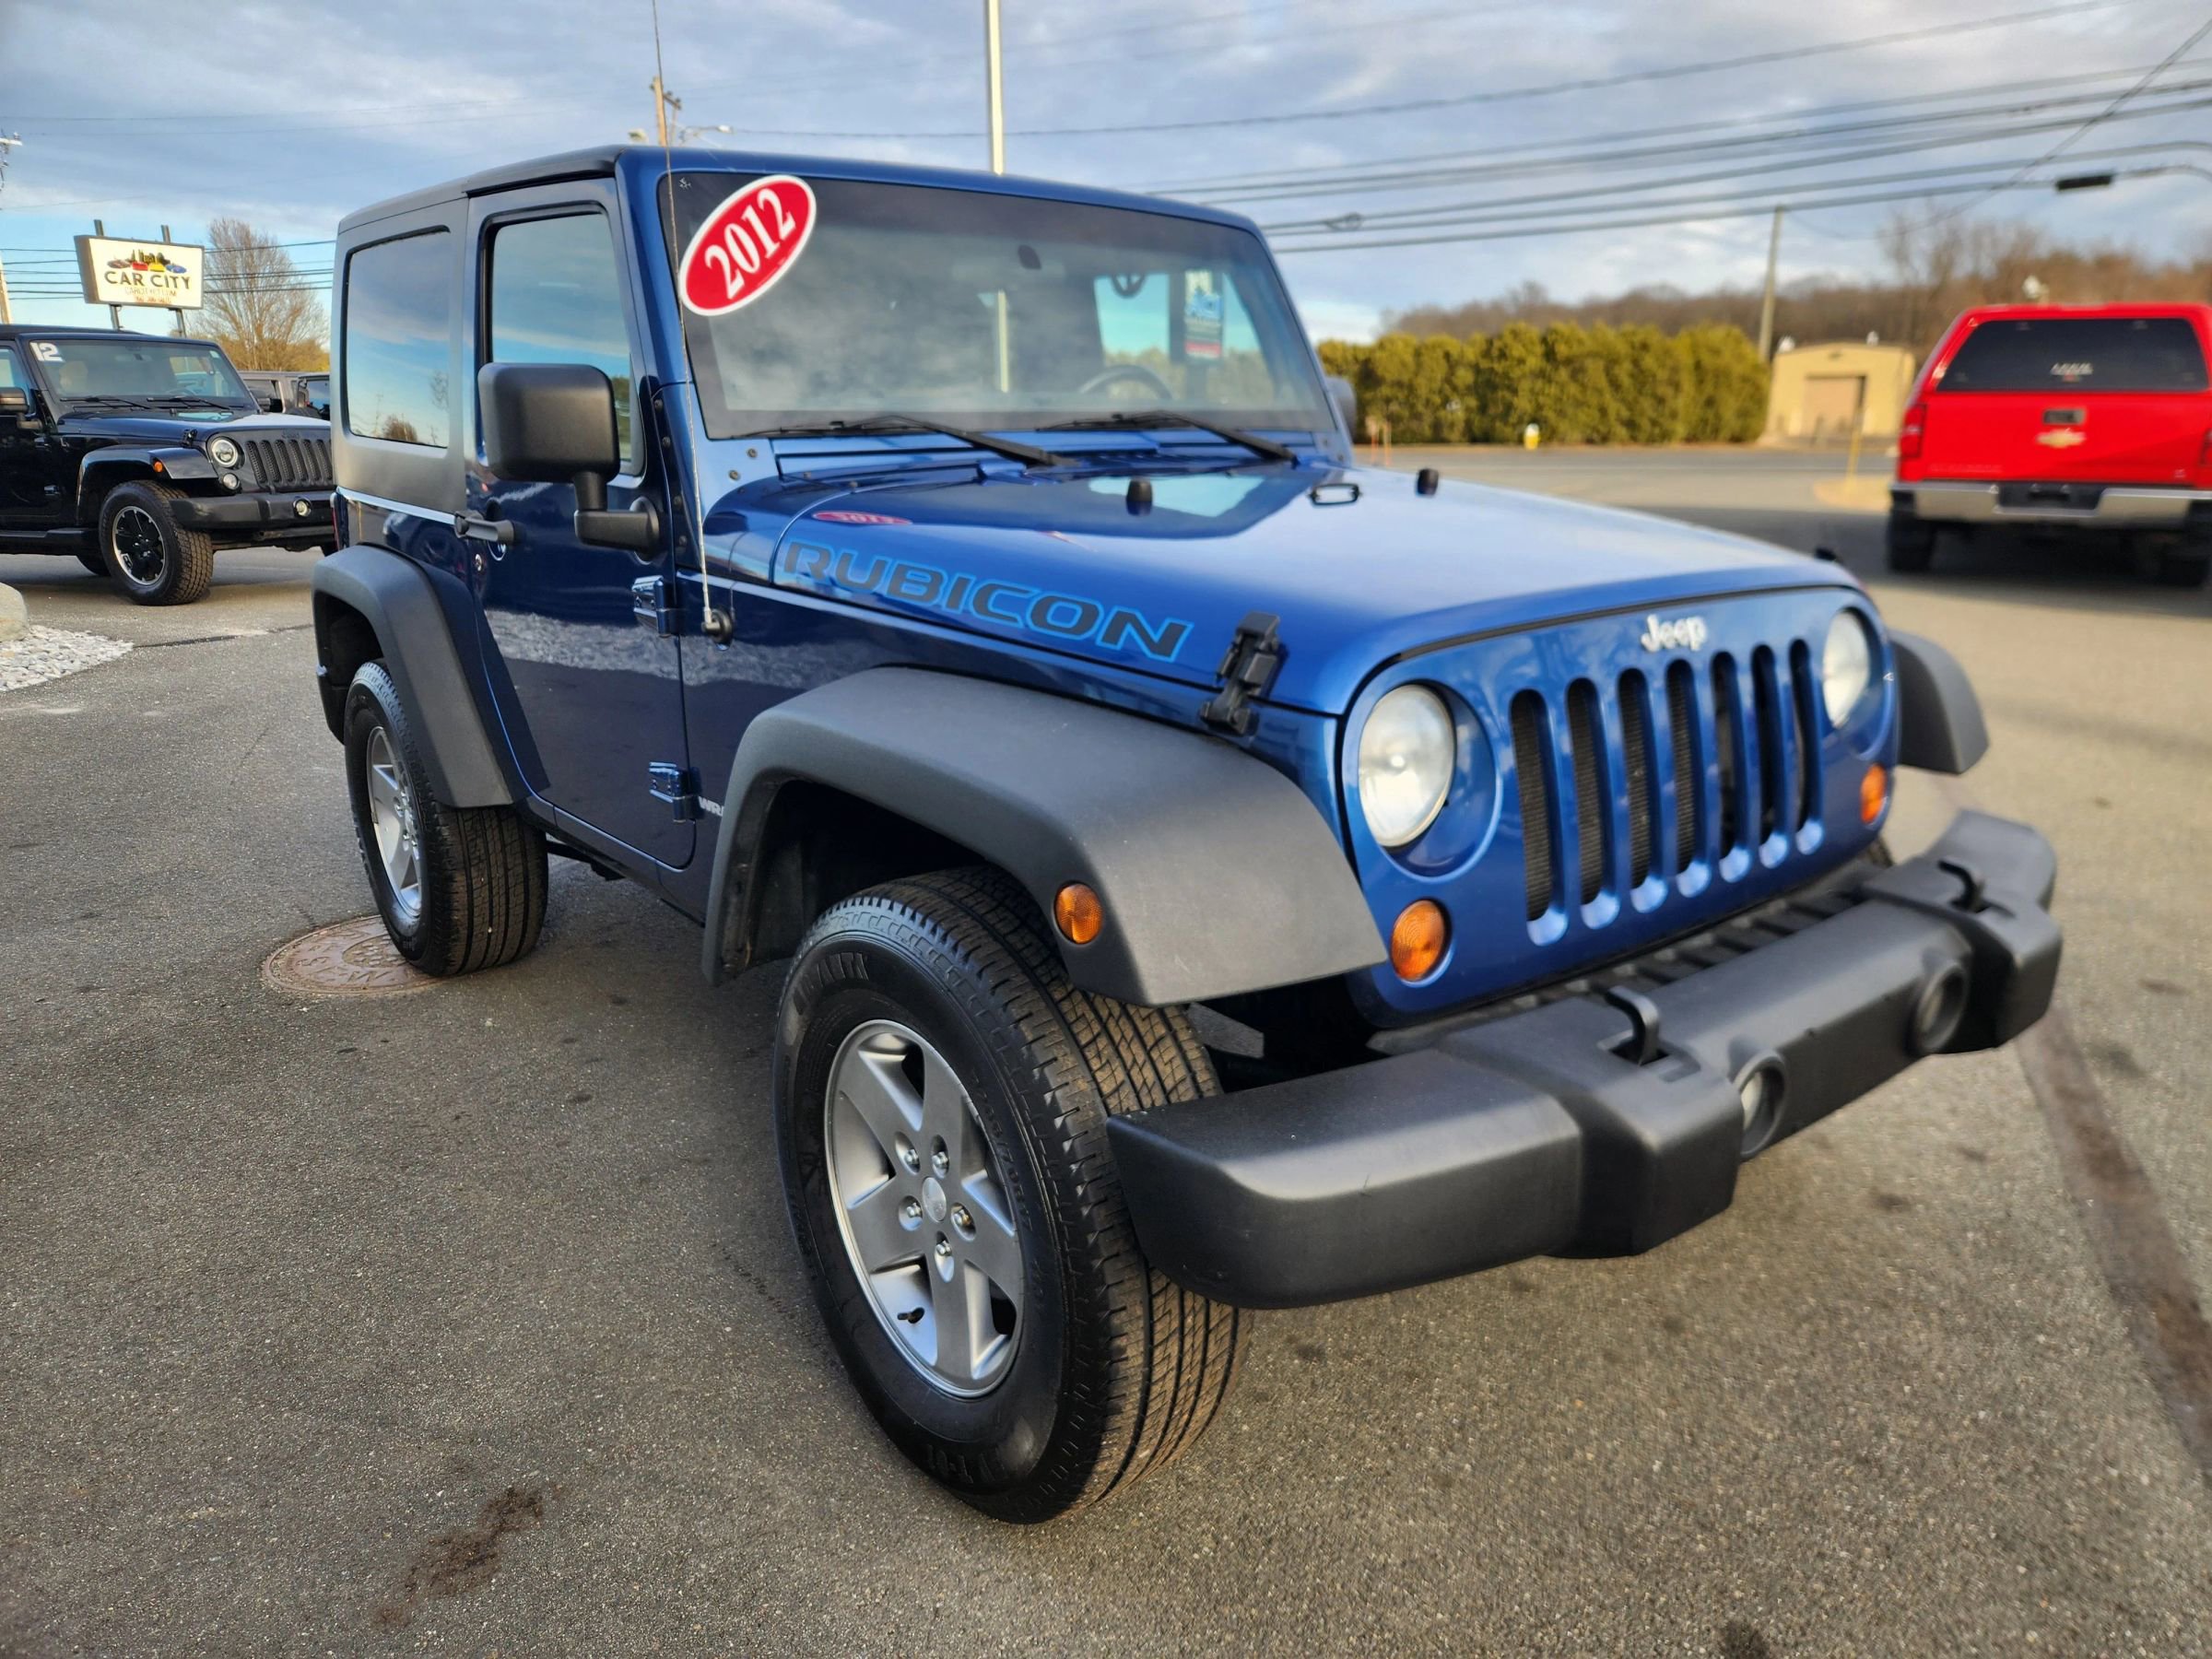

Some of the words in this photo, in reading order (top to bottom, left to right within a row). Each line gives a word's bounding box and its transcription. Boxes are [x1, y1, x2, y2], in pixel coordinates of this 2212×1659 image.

[704, 187, 796, 300] 2012
[104, 271, 145, 287] CAR
[150, 275, 190, 289] CITY
[29, 342, 64, 361] 12
[783, 541, 1194, 662] RUBICON
[1641, 614, 1708, 653] Jeep
